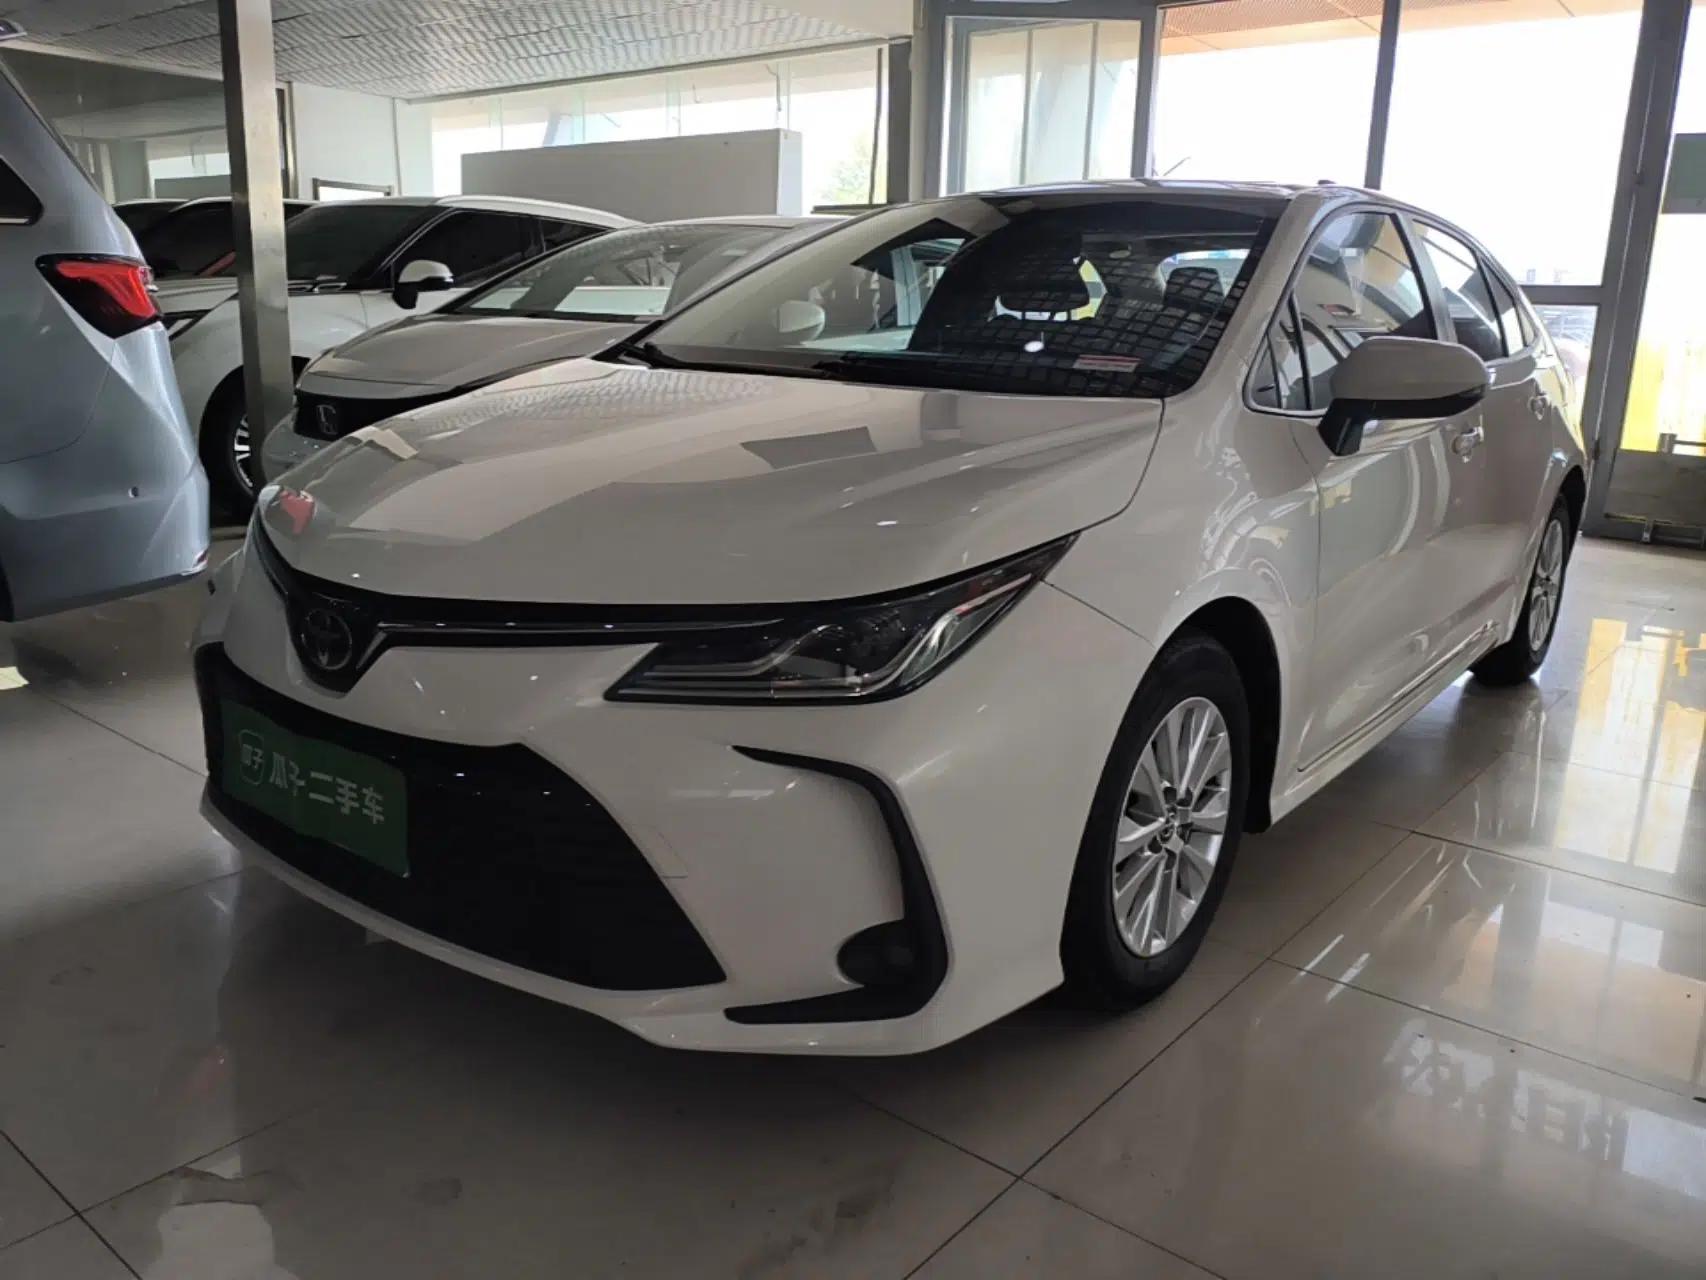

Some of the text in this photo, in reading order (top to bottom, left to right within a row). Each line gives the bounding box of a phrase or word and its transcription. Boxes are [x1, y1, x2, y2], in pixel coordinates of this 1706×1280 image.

[269, 752, 385, 825] 瓜子二手车
